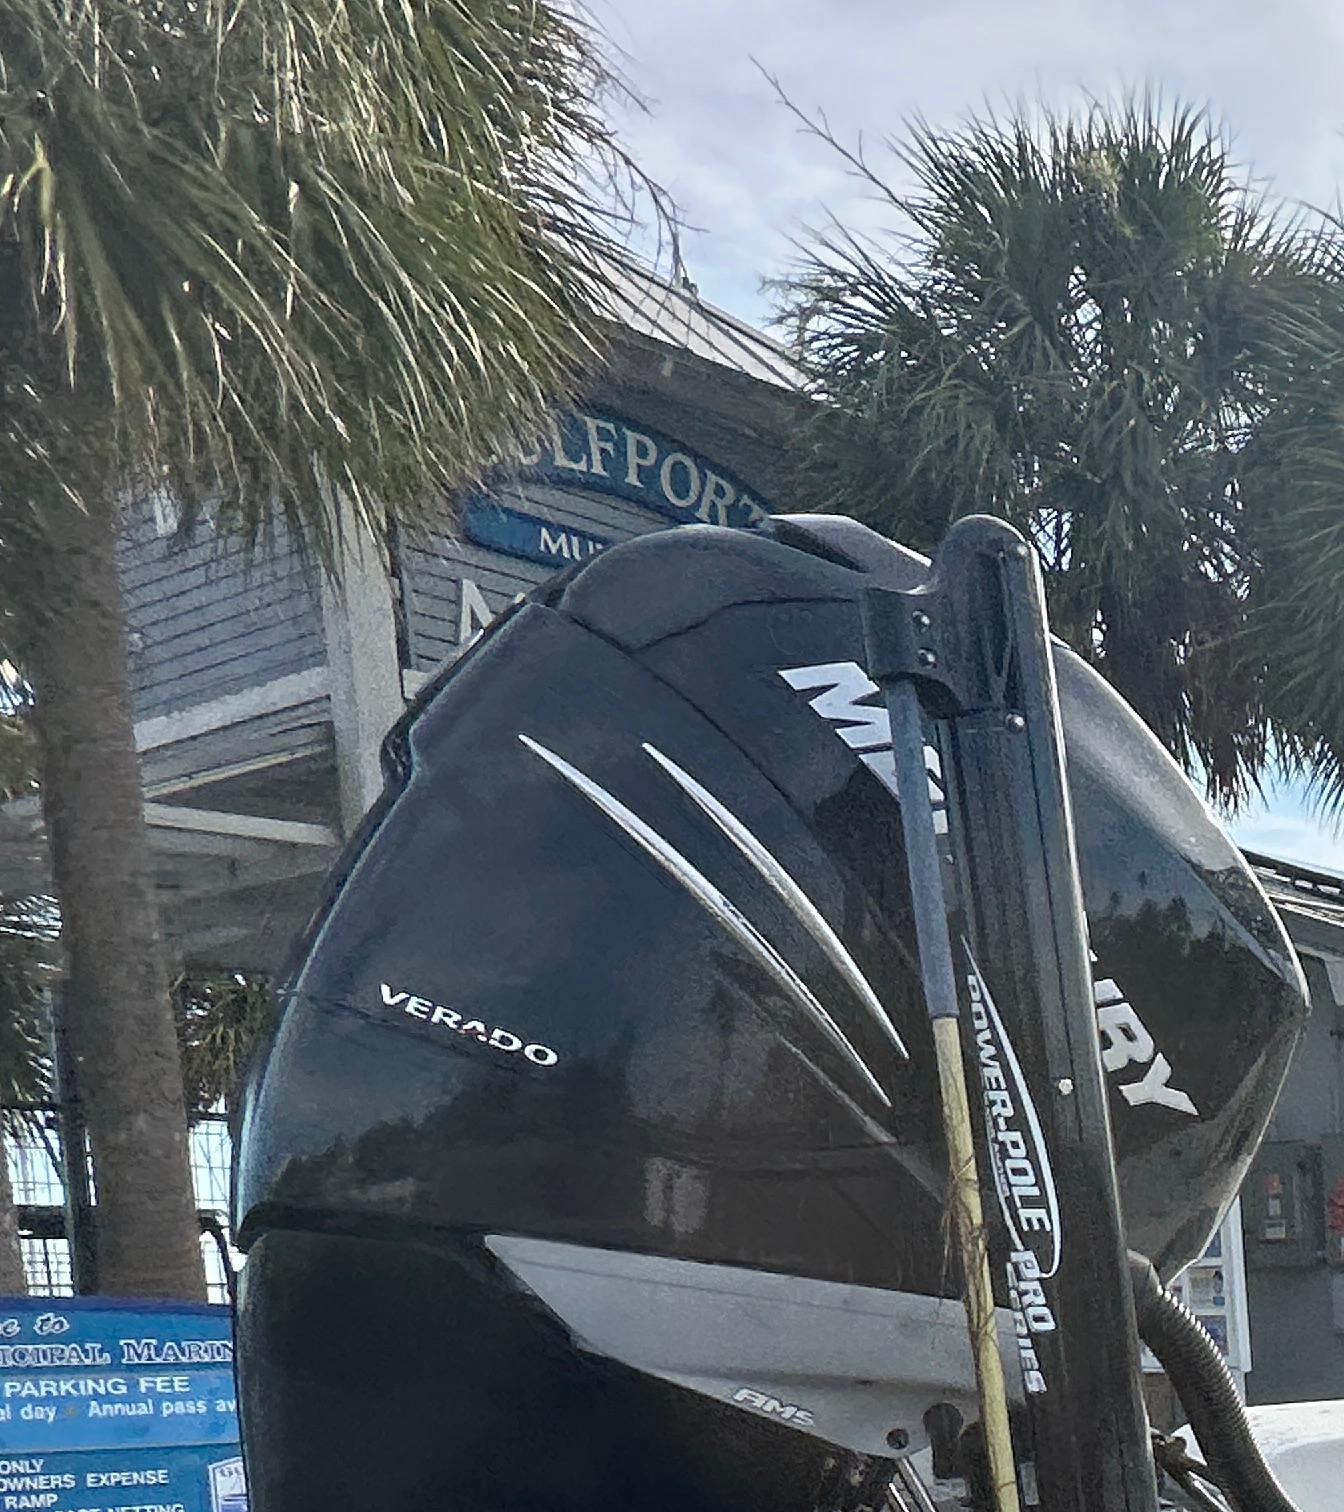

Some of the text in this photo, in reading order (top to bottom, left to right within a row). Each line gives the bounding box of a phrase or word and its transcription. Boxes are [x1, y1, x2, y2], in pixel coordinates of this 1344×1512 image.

[380, 983, 559, 1067] VERADO
[966, 973, 1053, 1234] POWER-POLE
[1009, 1250, 1057, 1334] PRO
[33, 1312, 71, 1336] to
[4, 1375, 191, 1398] PARKING FEE
[20, 1402, 57, 1423] day
[88, 1399, 153, 1418] Annual
[161, 1400, 208, 1418] pass
[0, 1459, 44, 1475] ONLY
[0, 1469, 169, 1493] OWNERS EXPENSE
[4, 1493, 58, 1511] RAMP
